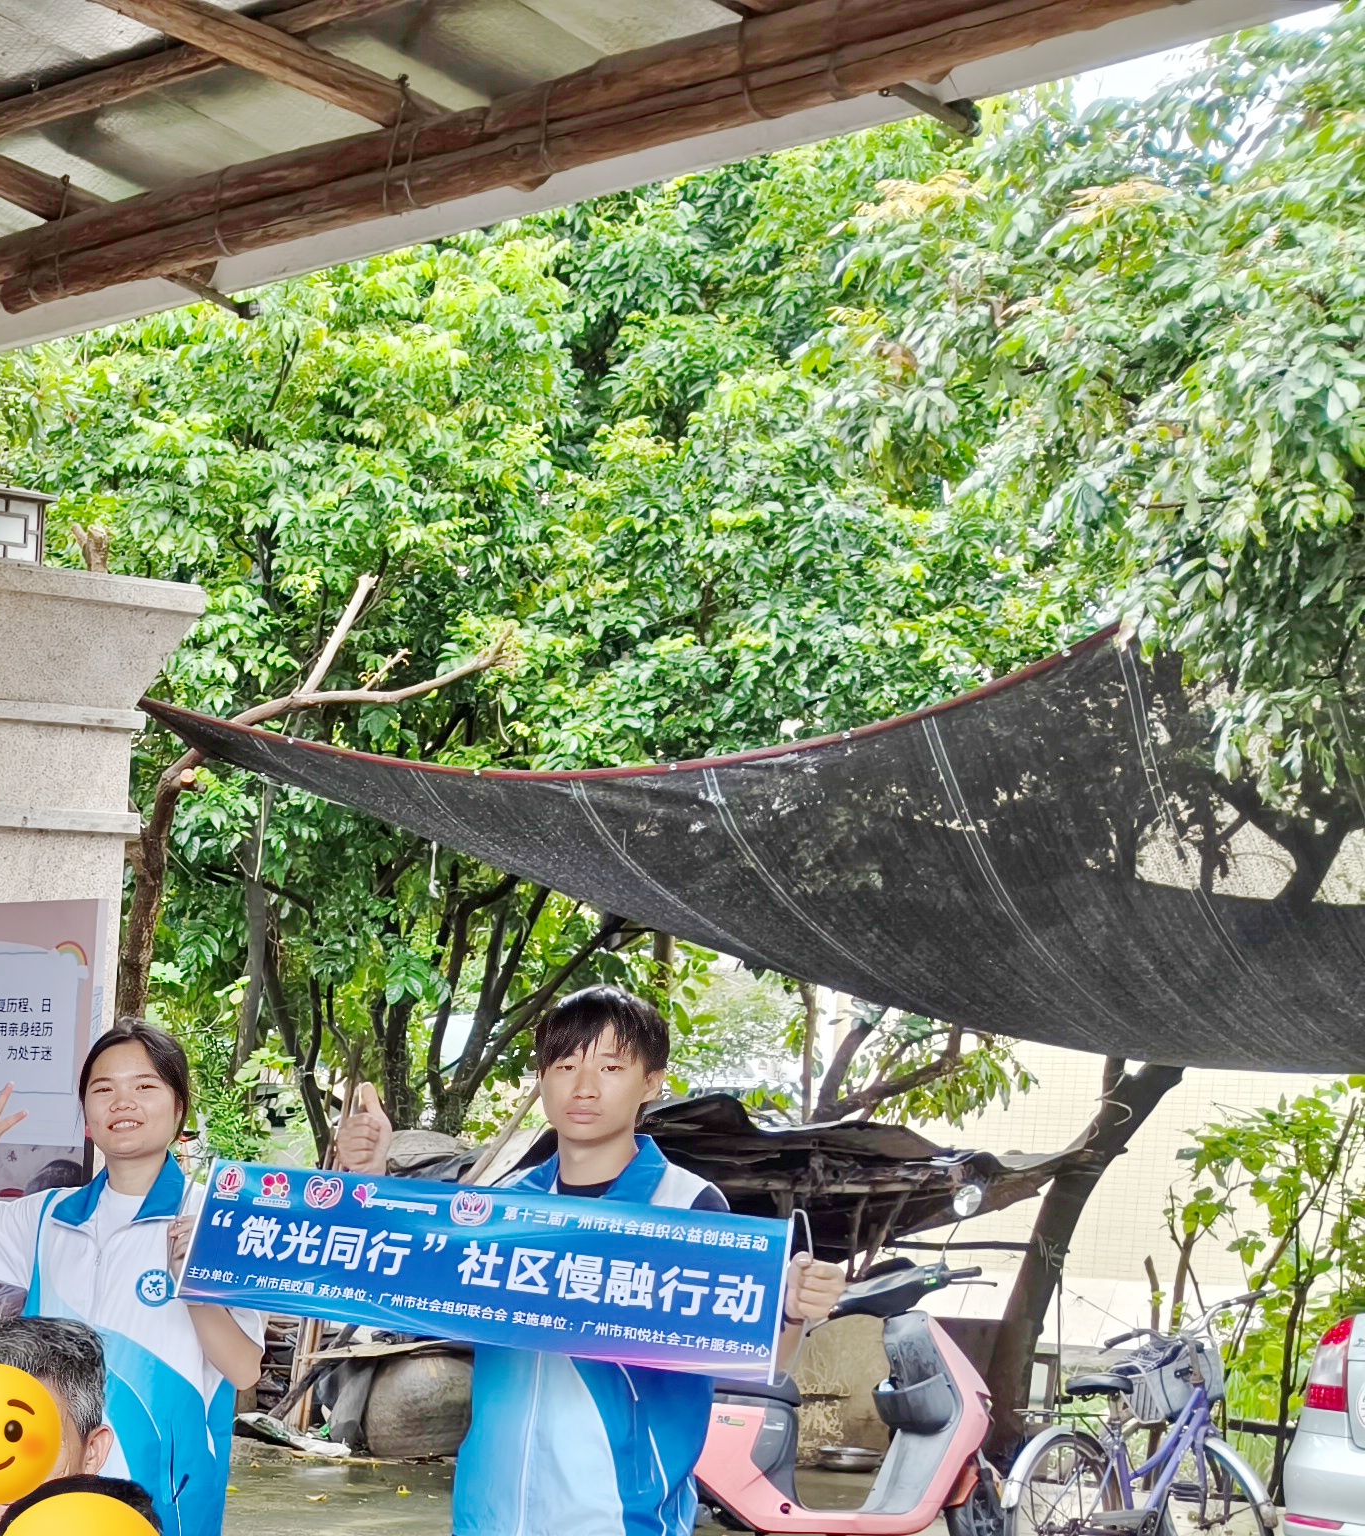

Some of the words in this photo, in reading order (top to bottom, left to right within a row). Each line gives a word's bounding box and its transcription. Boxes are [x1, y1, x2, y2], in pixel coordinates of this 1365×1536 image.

[502, 1206, 769, 1252] 第十三届广州市社会组织公益创投活动
[187, 1266, 315, 1295] 主办单位：广州市民政局
[318, 1284, 508, 1322] 承办单位：广州市社会组织联合会
[512, 1310, 770, 1358] 实施单位：广州市和悦社会工作服务中心
